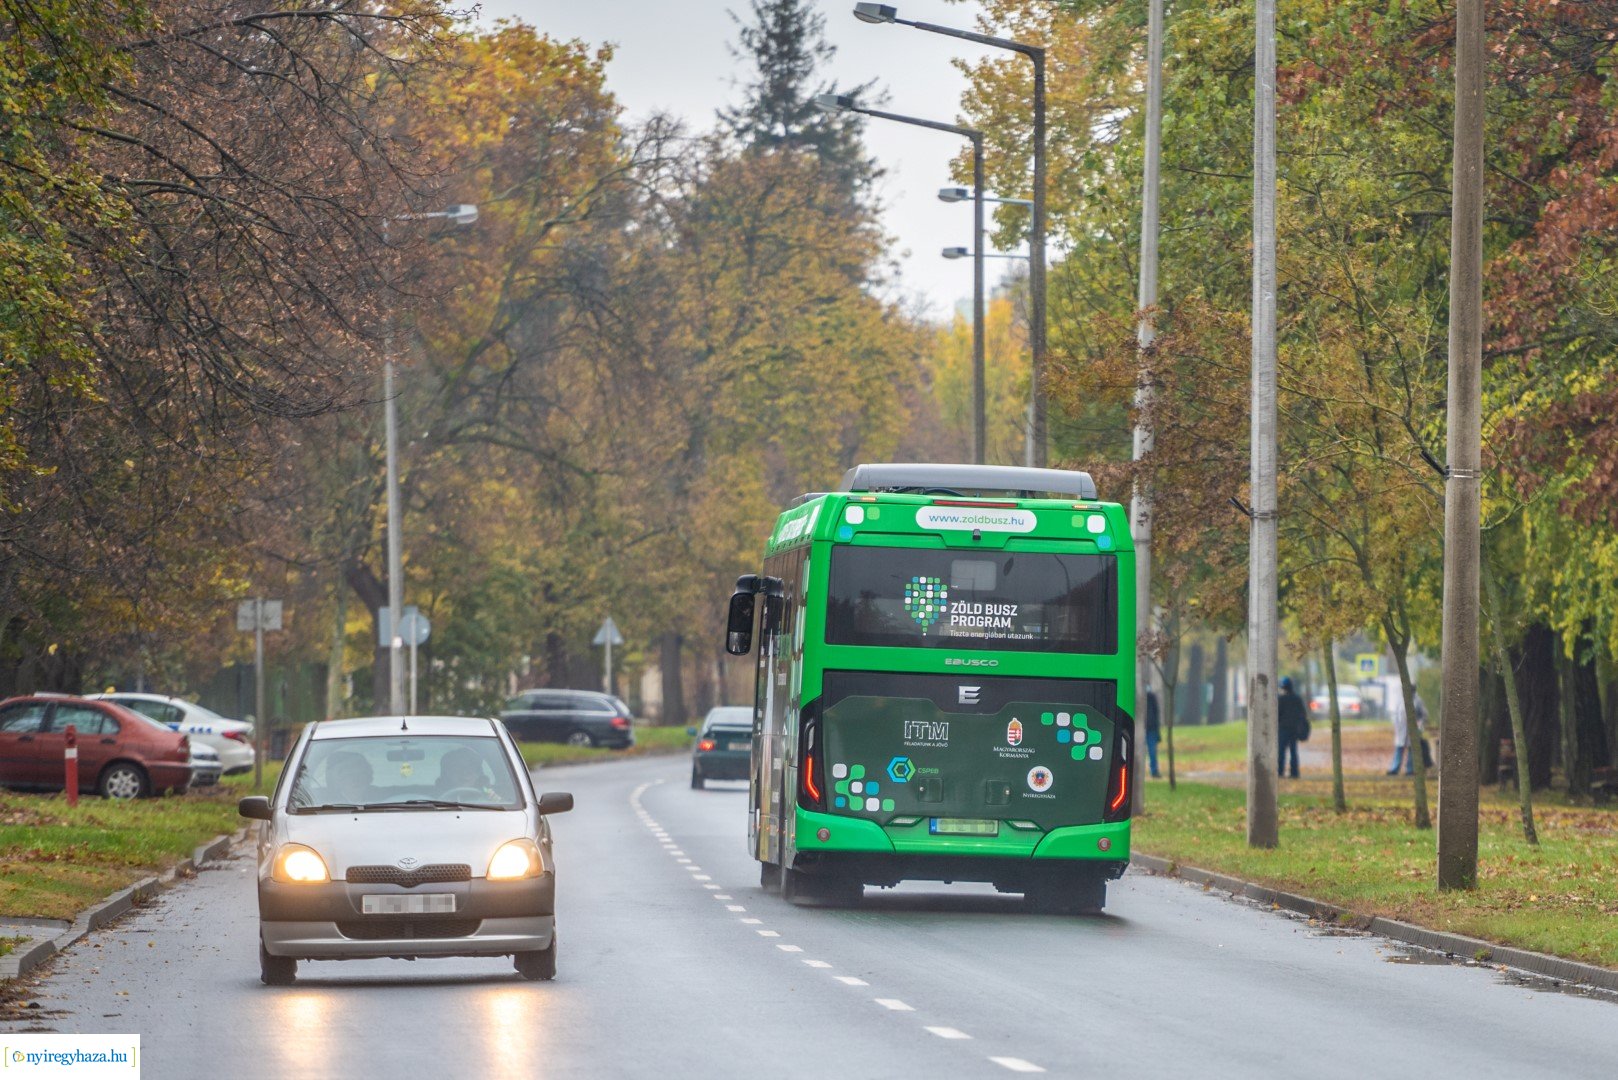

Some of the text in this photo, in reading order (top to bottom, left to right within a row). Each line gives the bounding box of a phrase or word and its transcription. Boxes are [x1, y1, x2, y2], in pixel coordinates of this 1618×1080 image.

[929, 515, 1025, 525] www.zoldbusz.hu
[951, 600, 1018, 616] ZÖLD BUSZ
[950, 615, 1012, 628] PROGRAM
[970, 631, 1007, 640] energiában
[945, 658, 999, 667] EBUSCO
[904, 720, 949, 741] ITM
